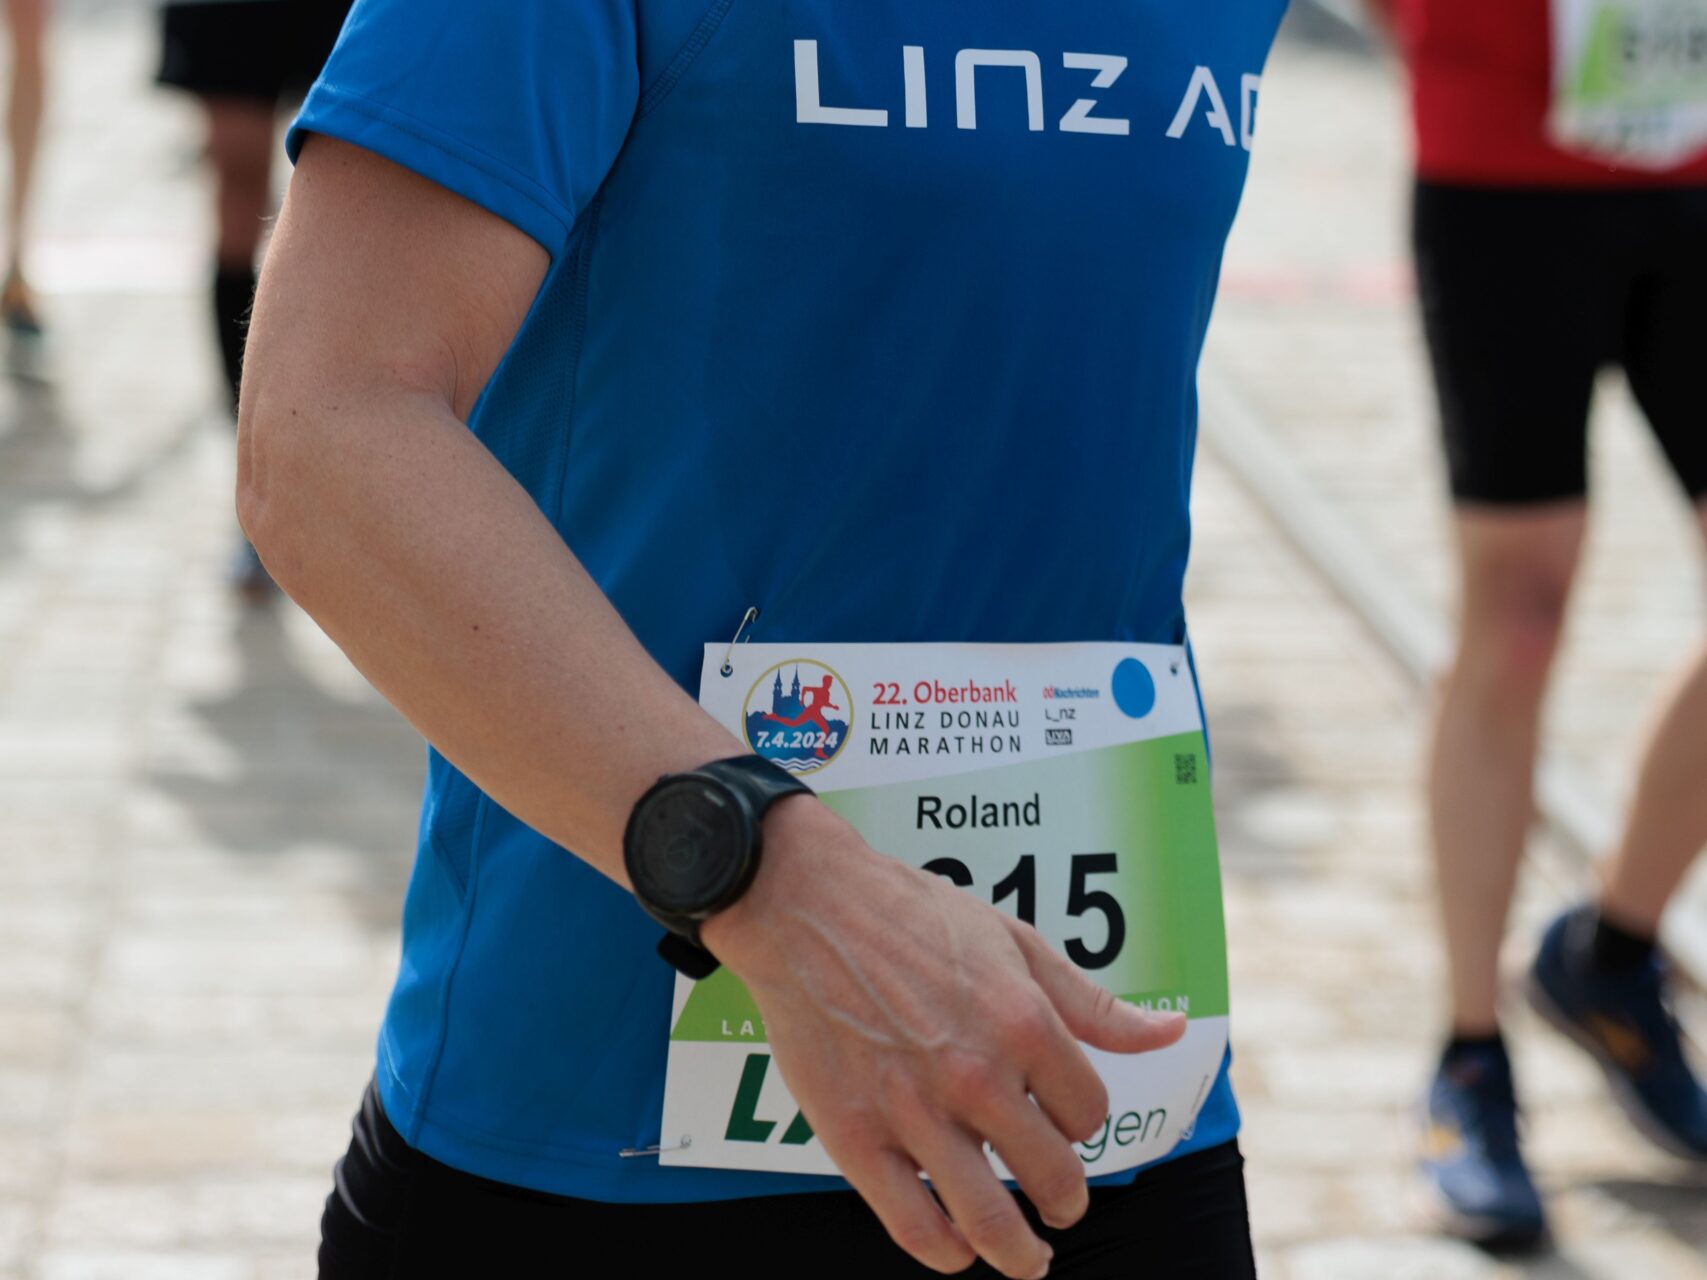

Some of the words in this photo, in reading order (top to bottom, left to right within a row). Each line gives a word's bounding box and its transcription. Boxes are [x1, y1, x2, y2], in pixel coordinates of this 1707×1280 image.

[872, 682, 908, 705] 22.
[914, 679, 1018, 704] Oberbank
[871, 711, 925, 730] LINZ
[940, 710, 1020, 729] DONAU
[757, 731, 839, 749] 7.4.2024
[869, 735, 1021, 755] MARATHON
[916, 792, 1041, 830] Roland
[722, 1019, 768, 1036] LA
